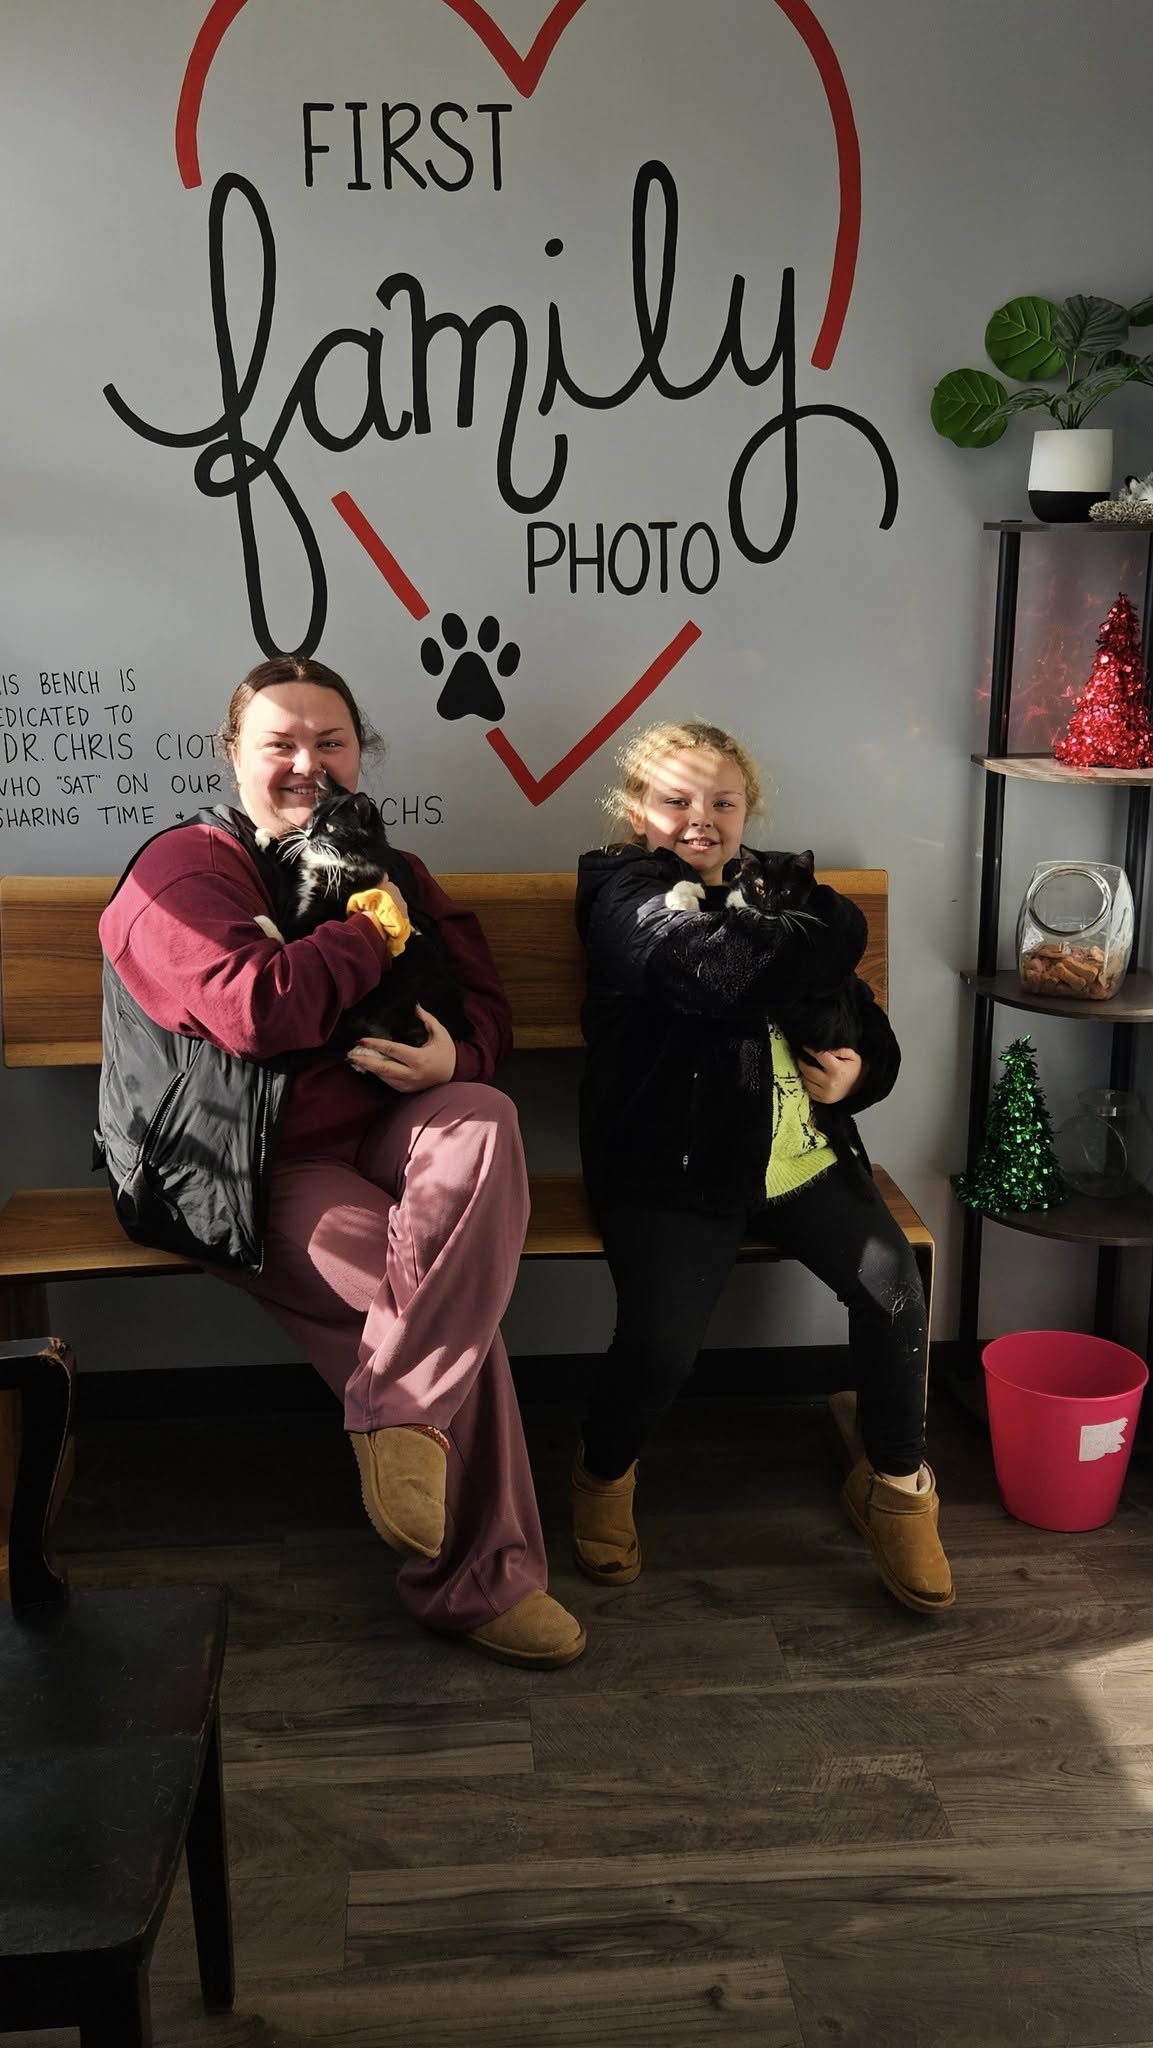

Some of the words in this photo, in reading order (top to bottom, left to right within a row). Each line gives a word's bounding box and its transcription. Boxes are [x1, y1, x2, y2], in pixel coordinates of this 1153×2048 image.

[303, 101, 513, 191] FIRST
[102, 159, 900, 660] family
[526, 521, 721, 596] PHOTO
[0, 673, 20, 696] IS
[40, 670, 100, 696] BENCH
[119, 668, 136, 692] IS
[104, 704, 133, 726] TO
[4, 732, 45, 764] DR.
[54, 732, 134, 762] CHRIS
[116, 772, 149, 795] ON
[170, 773, 223, 794] OUR
[97, 805, 155, 825] TIME
[175, 810, 185, 822] &
[369, 795, 445, 826] CHS.
